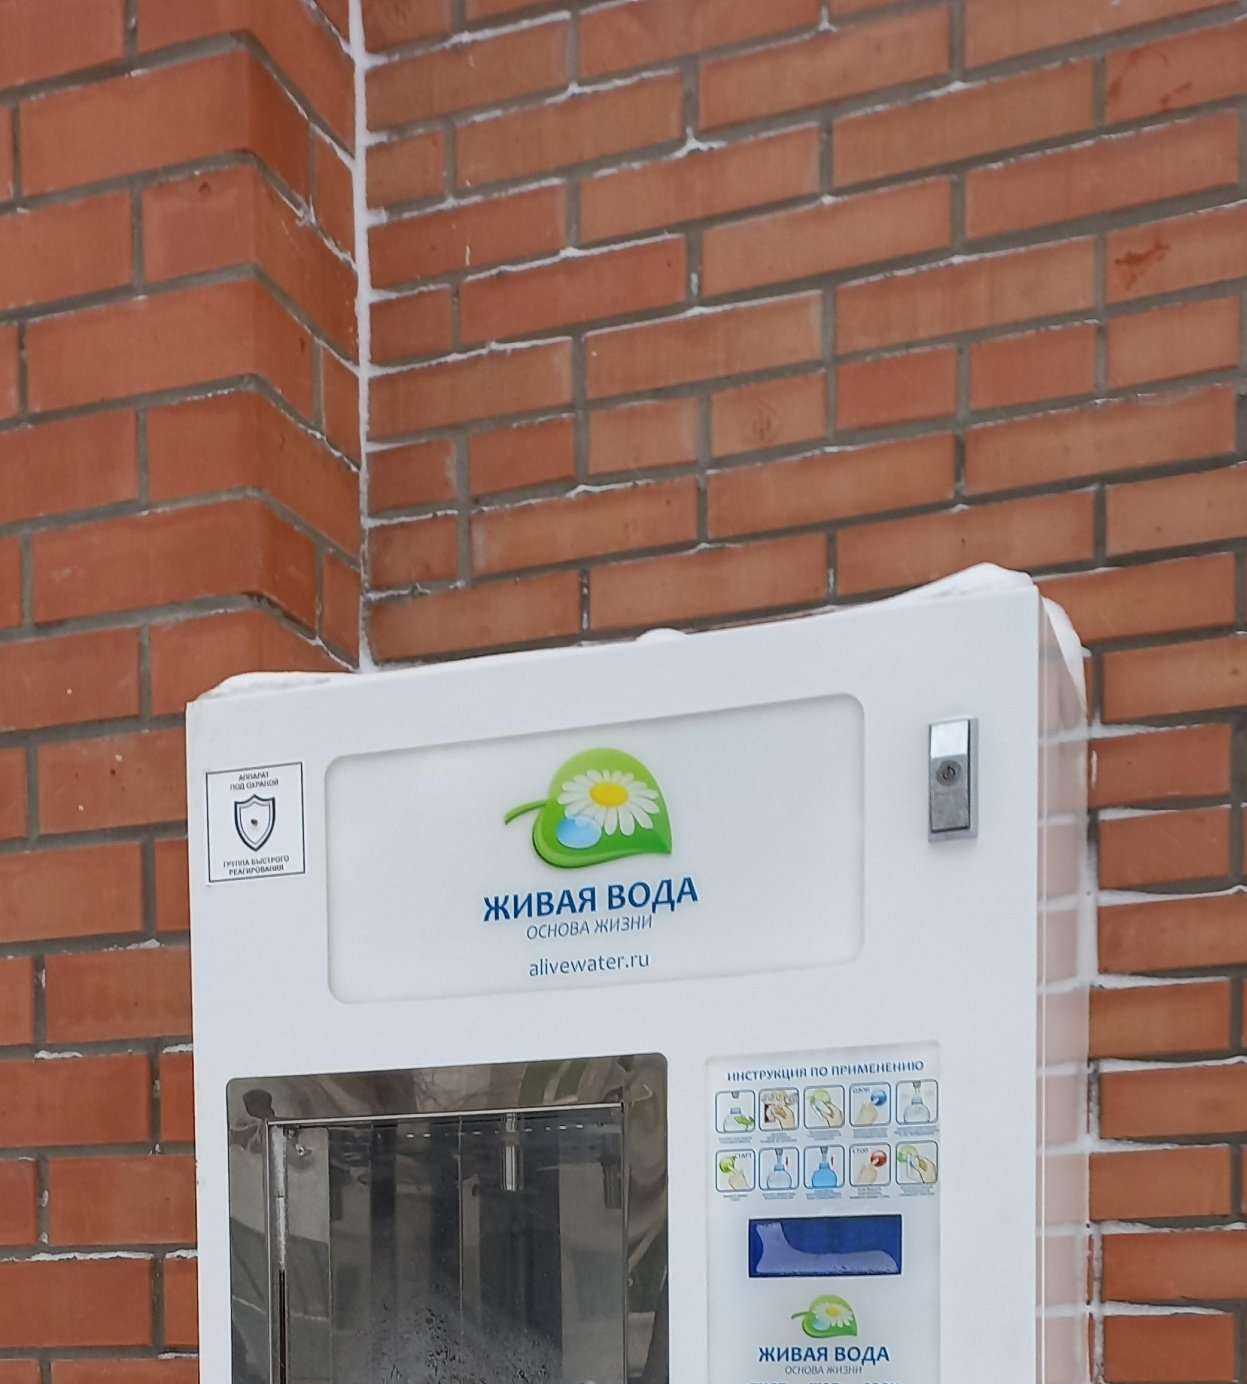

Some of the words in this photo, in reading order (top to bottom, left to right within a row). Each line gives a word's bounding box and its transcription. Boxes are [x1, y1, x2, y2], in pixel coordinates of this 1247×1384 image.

[238, 771, 269, 781] АППАРАТ
[230, 782, 245, 791] ПОД
[251, 855, 290, 866] БЫСТРОГО
[483, 886, 597, 922] ЖИВАЯ
[607, 877, 699, 914] ВОДА
[526, 921, 590, 940] ОСНОВА
[594, 914, 653, 934] ЖИЗНИ
[529, 953, 649, 977] alivewater.ru
[727, 1067, 807, 1081] ИНСТРУКЦИЯ
[810, 1066, 829, 1077] ПО
[831, 1060, 924, 1075] ПРИМЕНЕНИЮ
[758, 1346, 828, 1363] ЖИВАЯ
[834, 1346, 890, 1365] ВОДА
[784, 1365, 824, 1375] ОСНОВА
[826, 1365, 862, 1375] ЖИЗНИ
